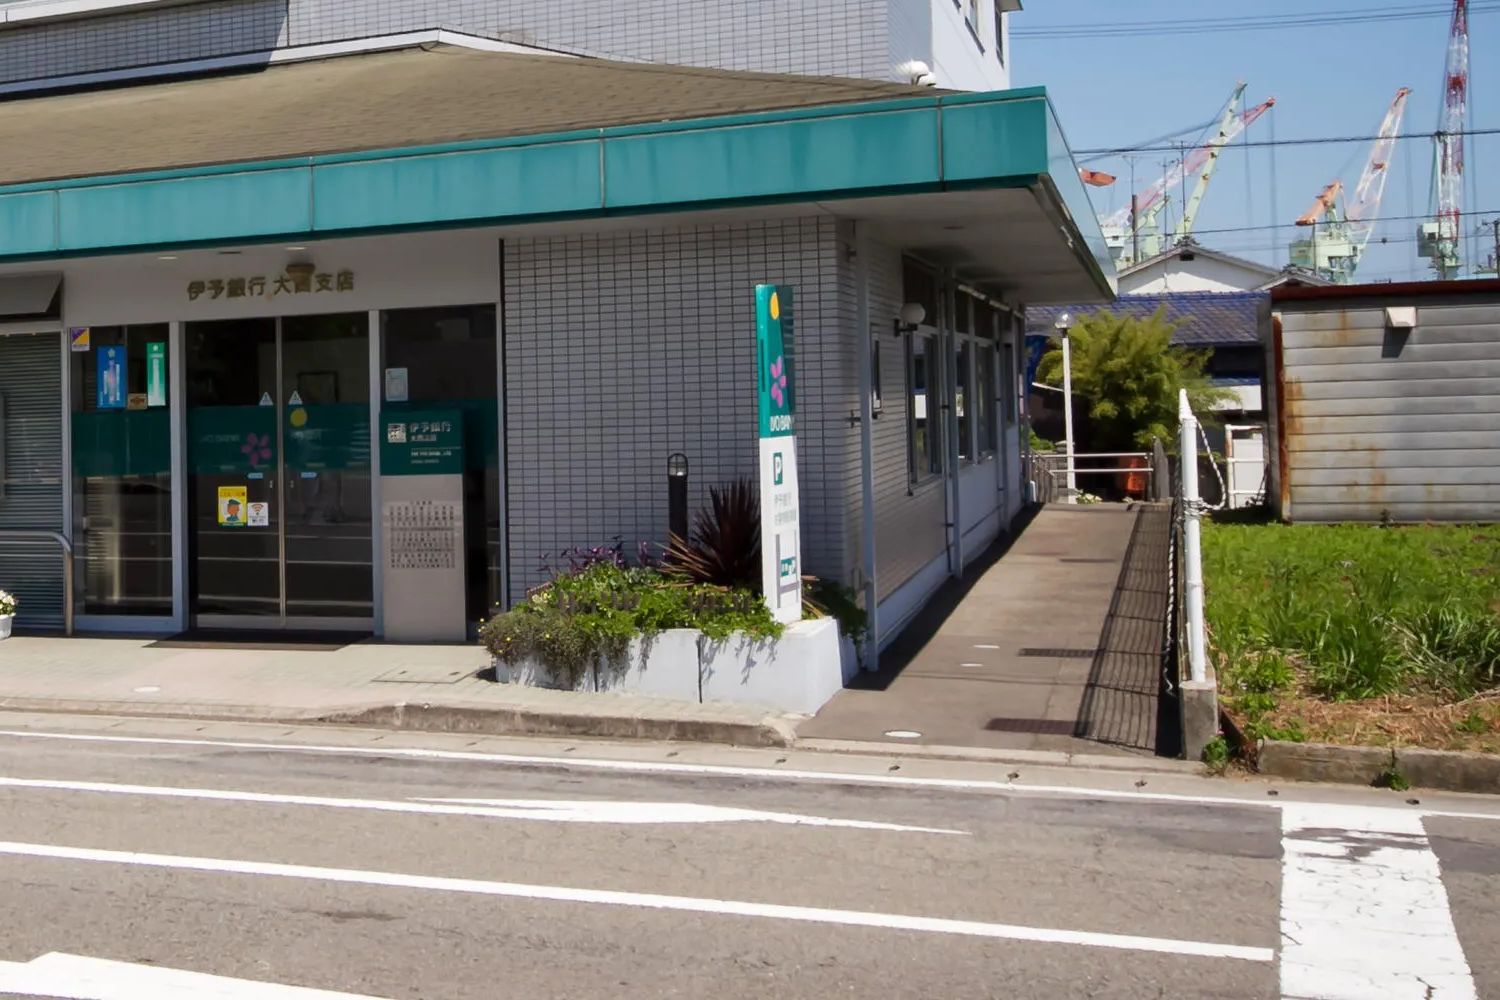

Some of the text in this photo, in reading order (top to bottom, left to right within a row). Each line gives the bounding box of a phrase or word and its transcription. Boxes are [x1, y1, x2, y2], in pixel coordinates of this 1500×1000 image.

[187, 276, 266, 301] 伊予銀行
[775, 456, 781, 481] P
